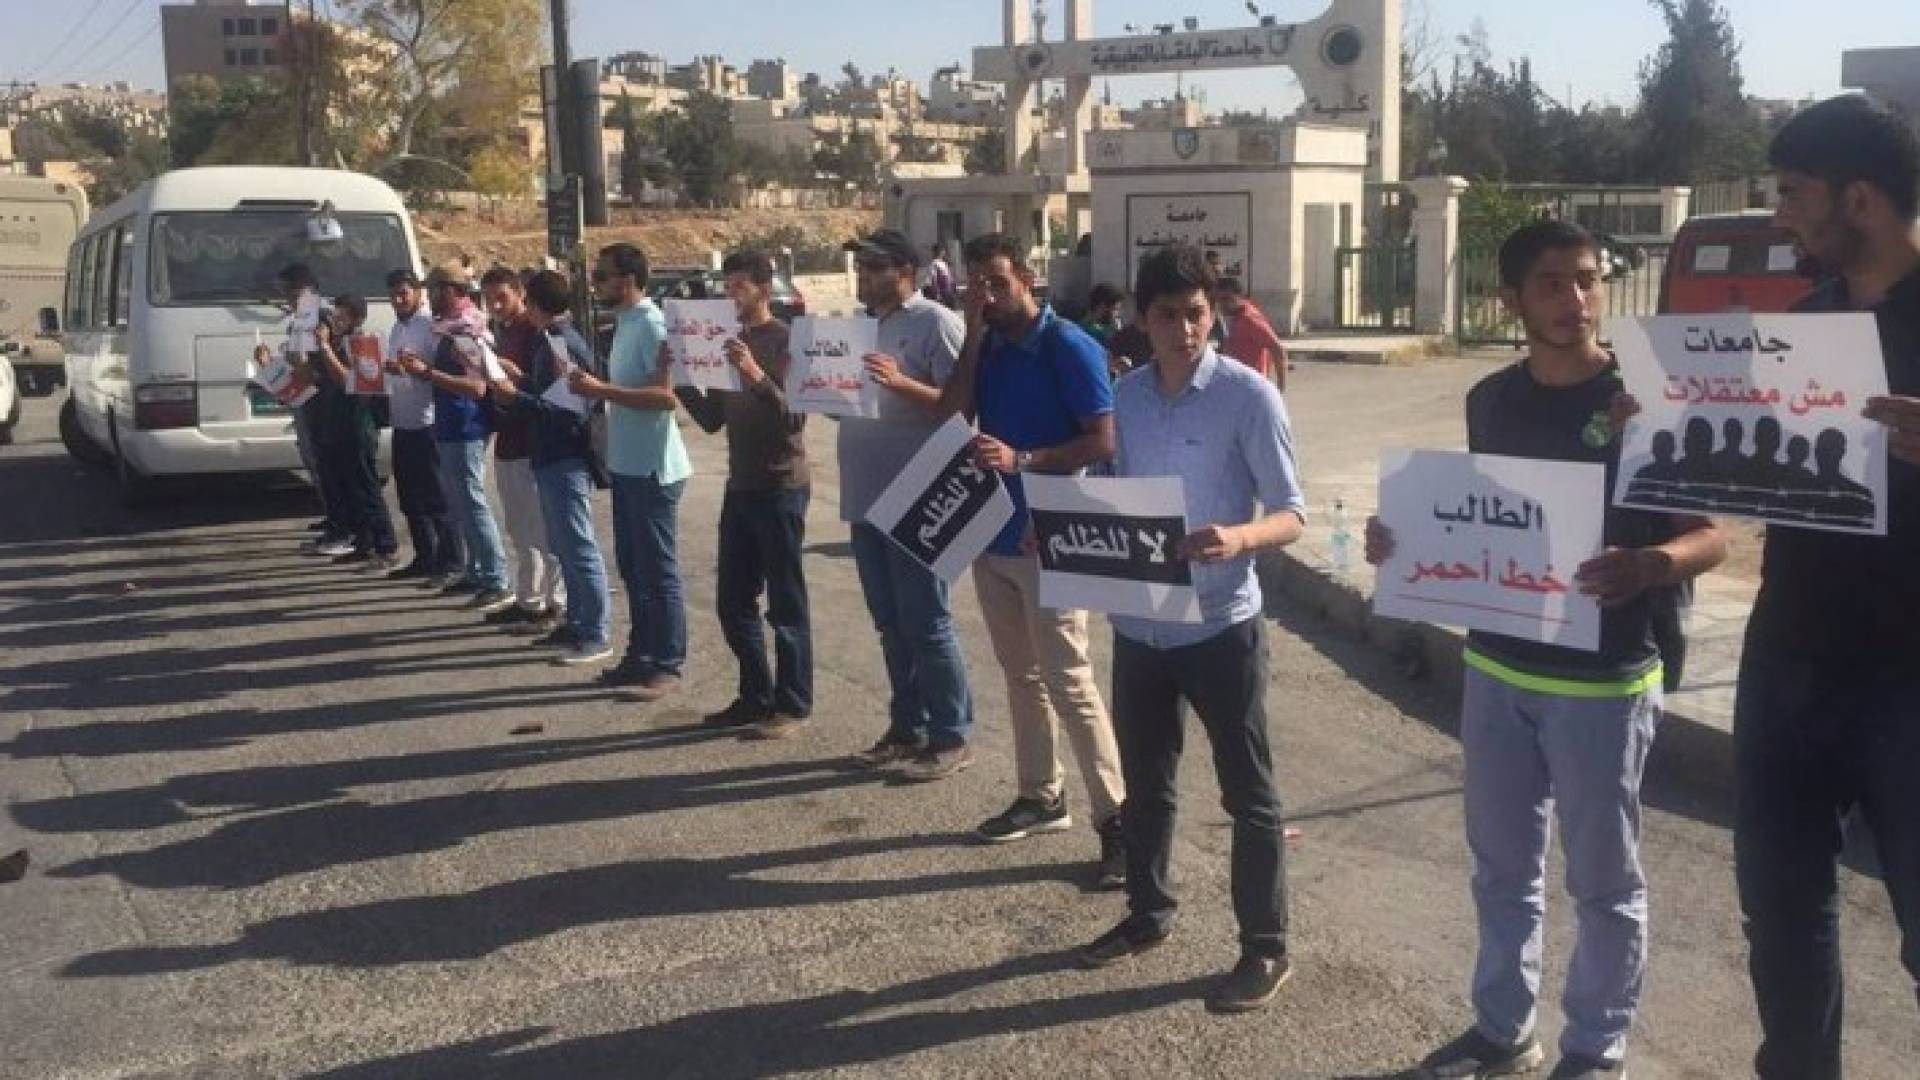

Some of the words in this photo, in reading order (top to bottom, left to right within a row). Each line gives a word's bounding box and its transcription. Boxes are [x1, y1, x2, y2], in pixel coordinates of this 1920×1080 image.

[1205, 34, 1264, 60] جامعة
[1165, 203, 1207, 221] جامعة
[1684, 326, 1793, 364] جامعات
[1664, 374, 1780, 405] معتقلات
[1790, 378, 1847, 416] مش
[917, 477, 970, 550] للظلم
[1433, 493, 1543, 534] الطالب
[1048, 522, 1130, 566] للظلم
[1136, 528, 1168, 563] لا
[1403, 548, 1490, 584] أحمر
[1499, 556, 1571, 593] خط
